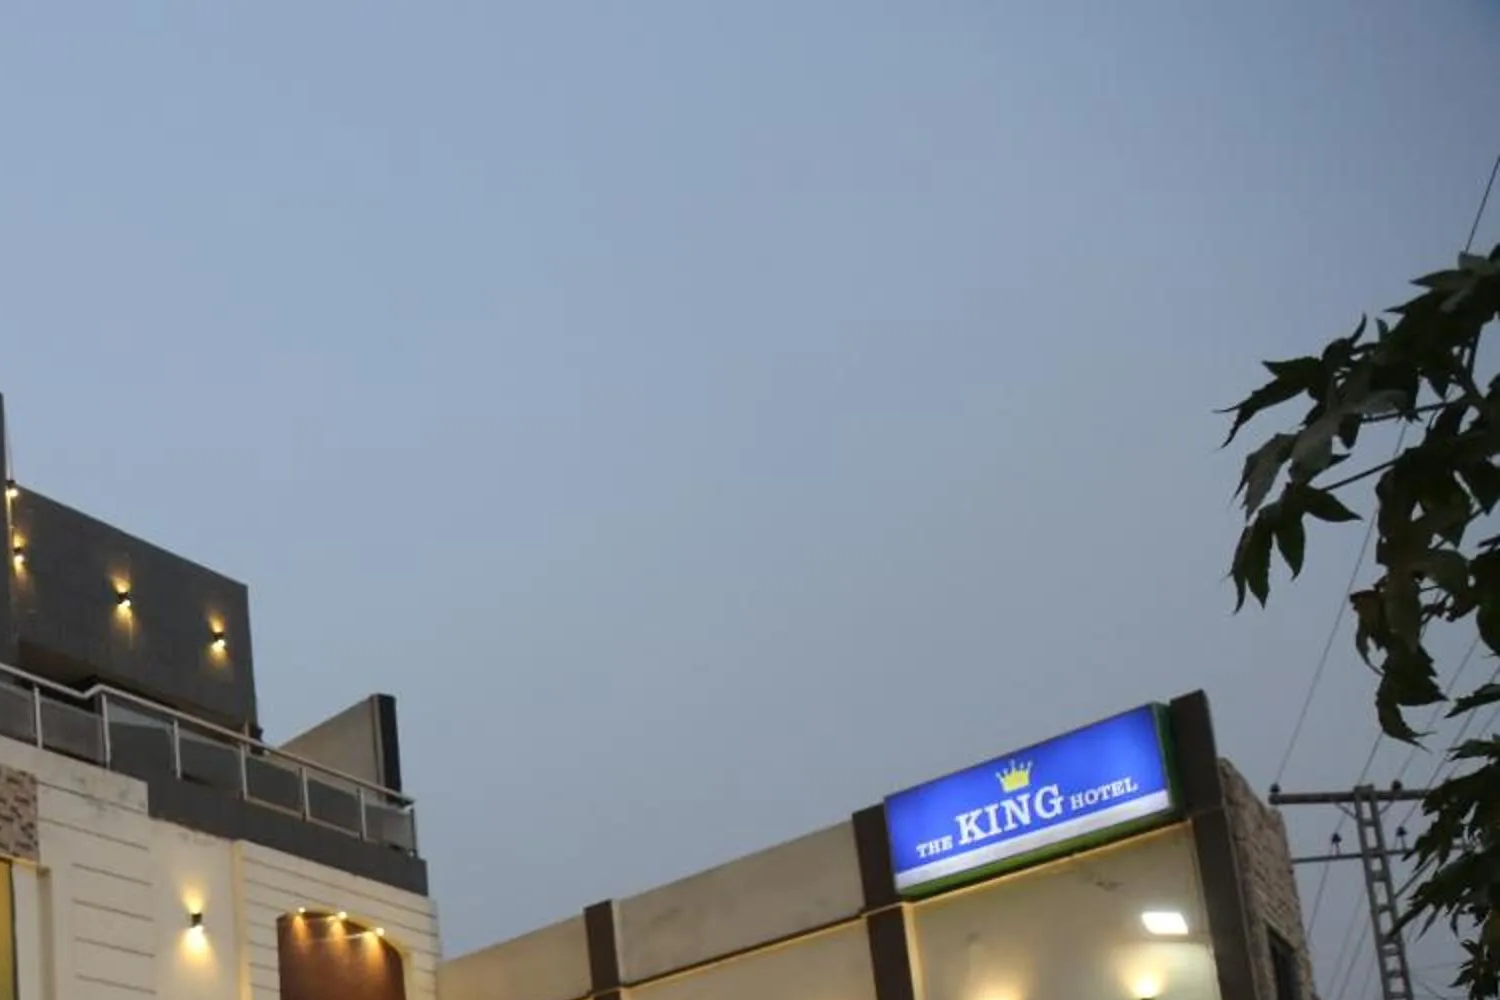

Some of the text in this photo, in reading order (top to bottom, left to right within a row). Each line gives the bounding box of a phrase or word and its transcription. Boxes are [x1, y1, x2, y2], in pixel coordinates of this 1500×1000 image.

[916, 778, 1138, 858] THE KING HOTEL
